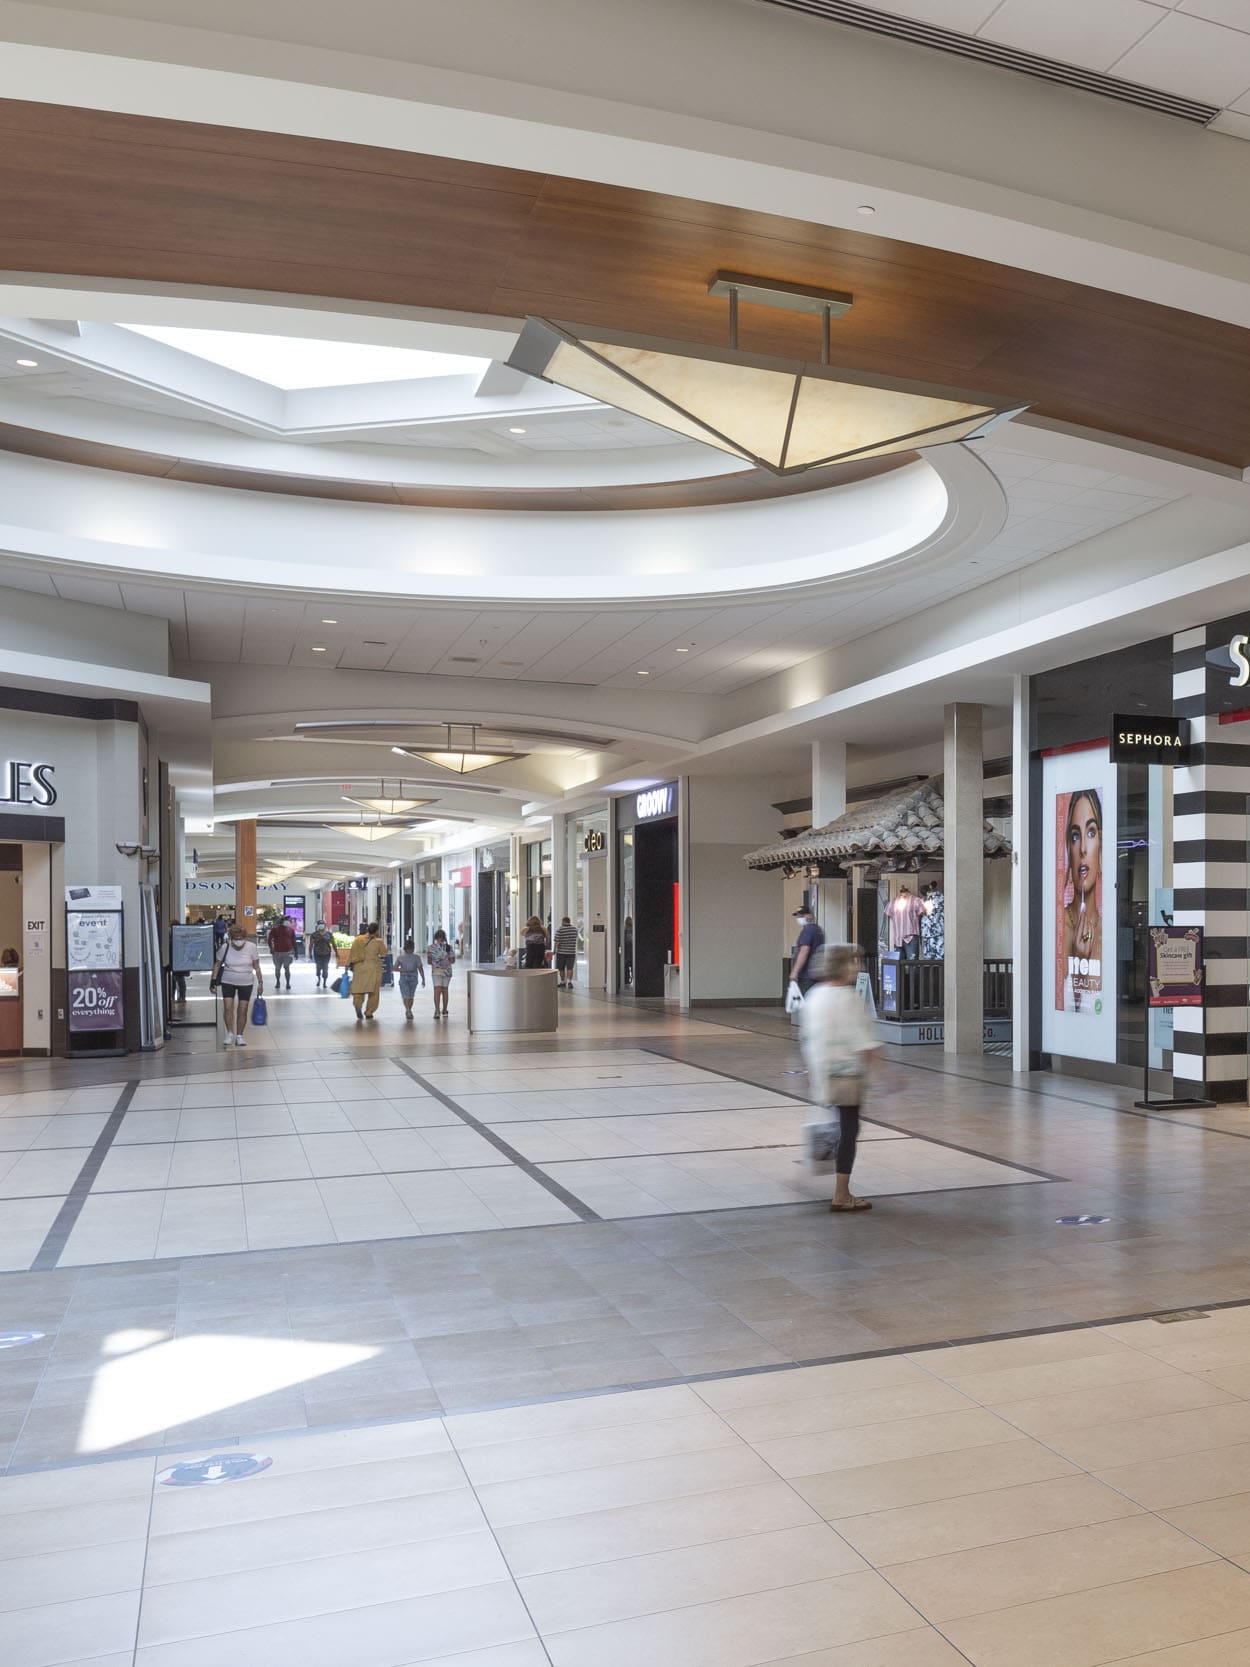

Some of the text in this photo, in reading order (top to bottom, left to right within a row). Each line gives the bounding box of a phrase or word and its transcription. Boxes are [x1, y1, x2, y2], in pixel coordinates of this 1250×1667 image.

[1119, 733, 1182, 747] SEPHORA
[0, 761, 57, 806] ES
[27, 920, 45, 930] EXIT
[79, 919, 107, 927] event
[1068, 977, 1099, 988] EAUTY
[72, 987, 118, 1009] 20% off
[72, 1008, 116, 1016] everything
[918, 1028, 944, 1041] HOLL
